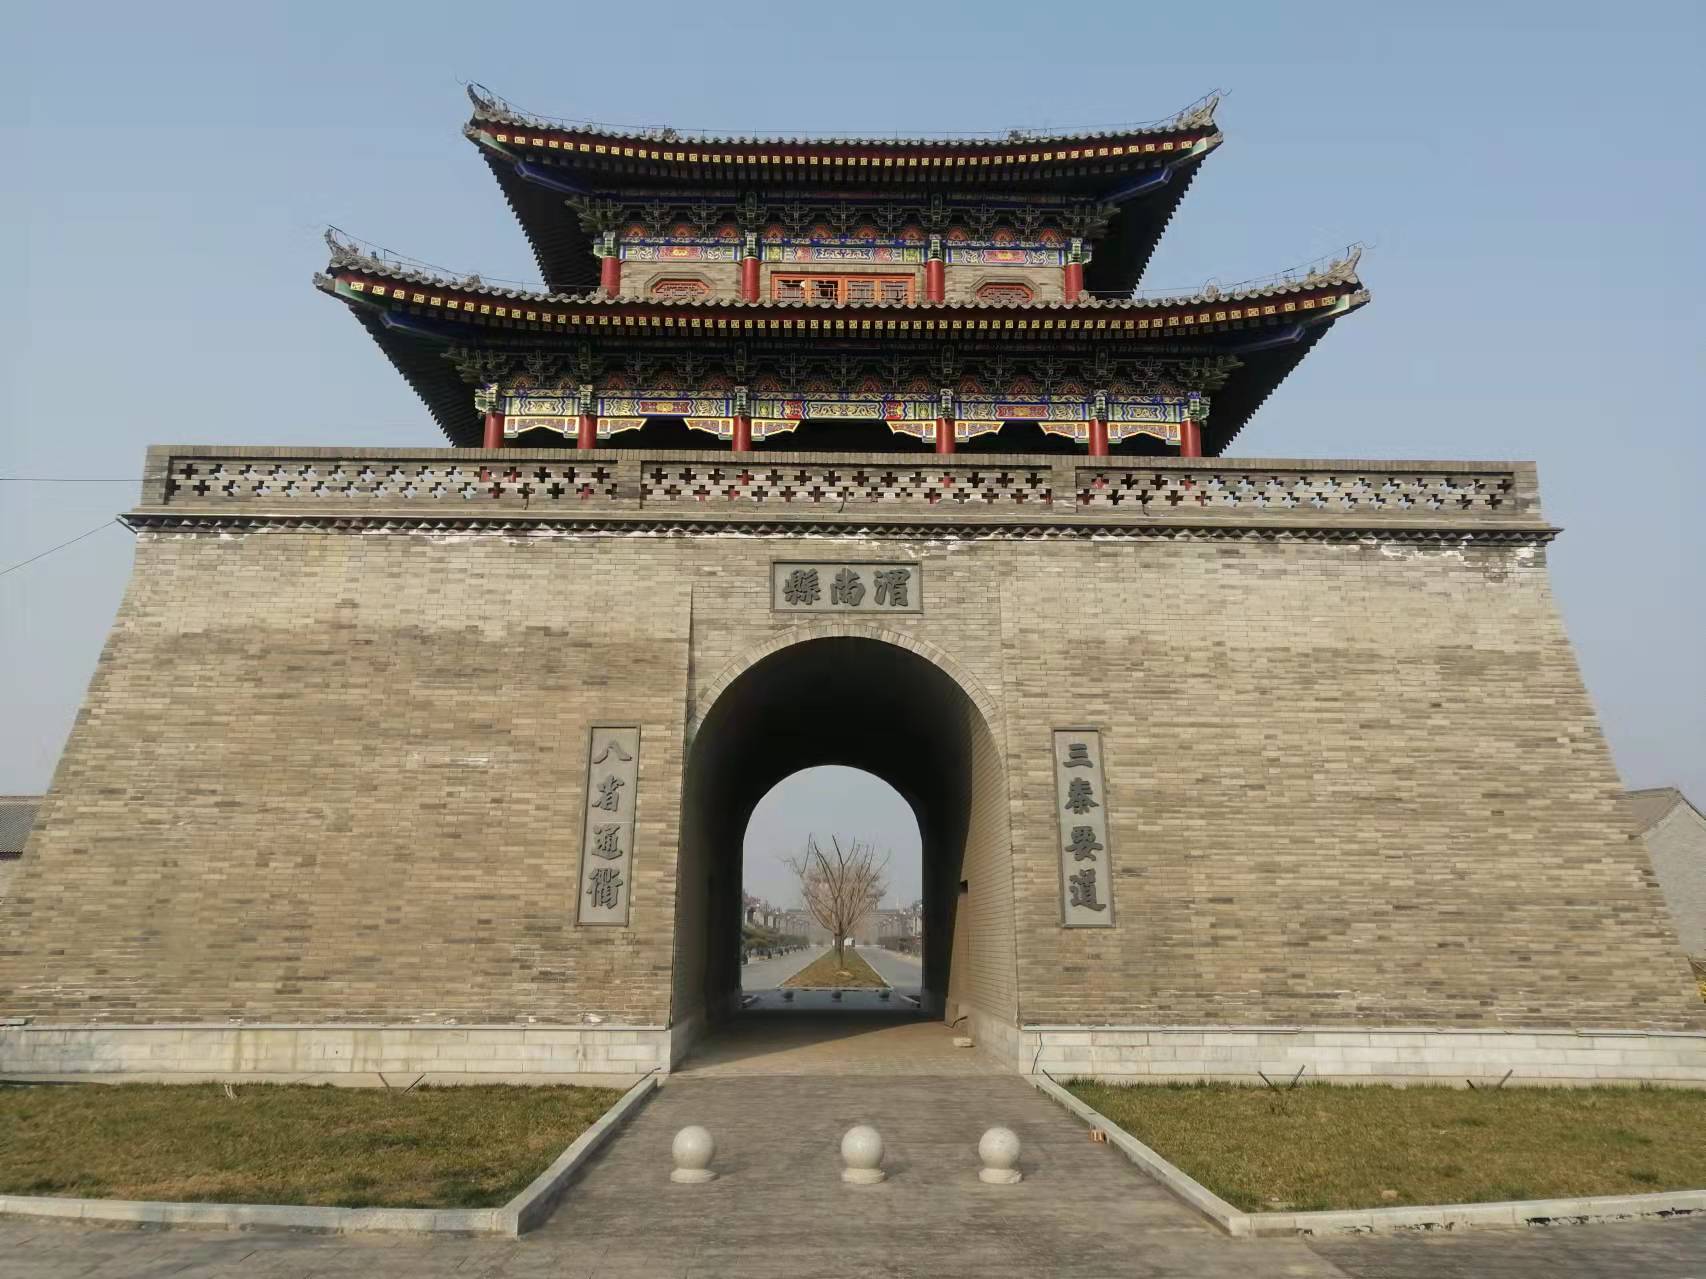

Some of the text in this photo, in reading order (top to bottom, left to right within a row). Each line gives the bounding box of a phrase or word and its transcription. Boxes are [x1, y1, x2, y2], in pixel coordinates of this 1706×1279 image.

[586, 740, 632, 909] 八省通衢
[1063, 743, 1106, 911] 三秦要道
